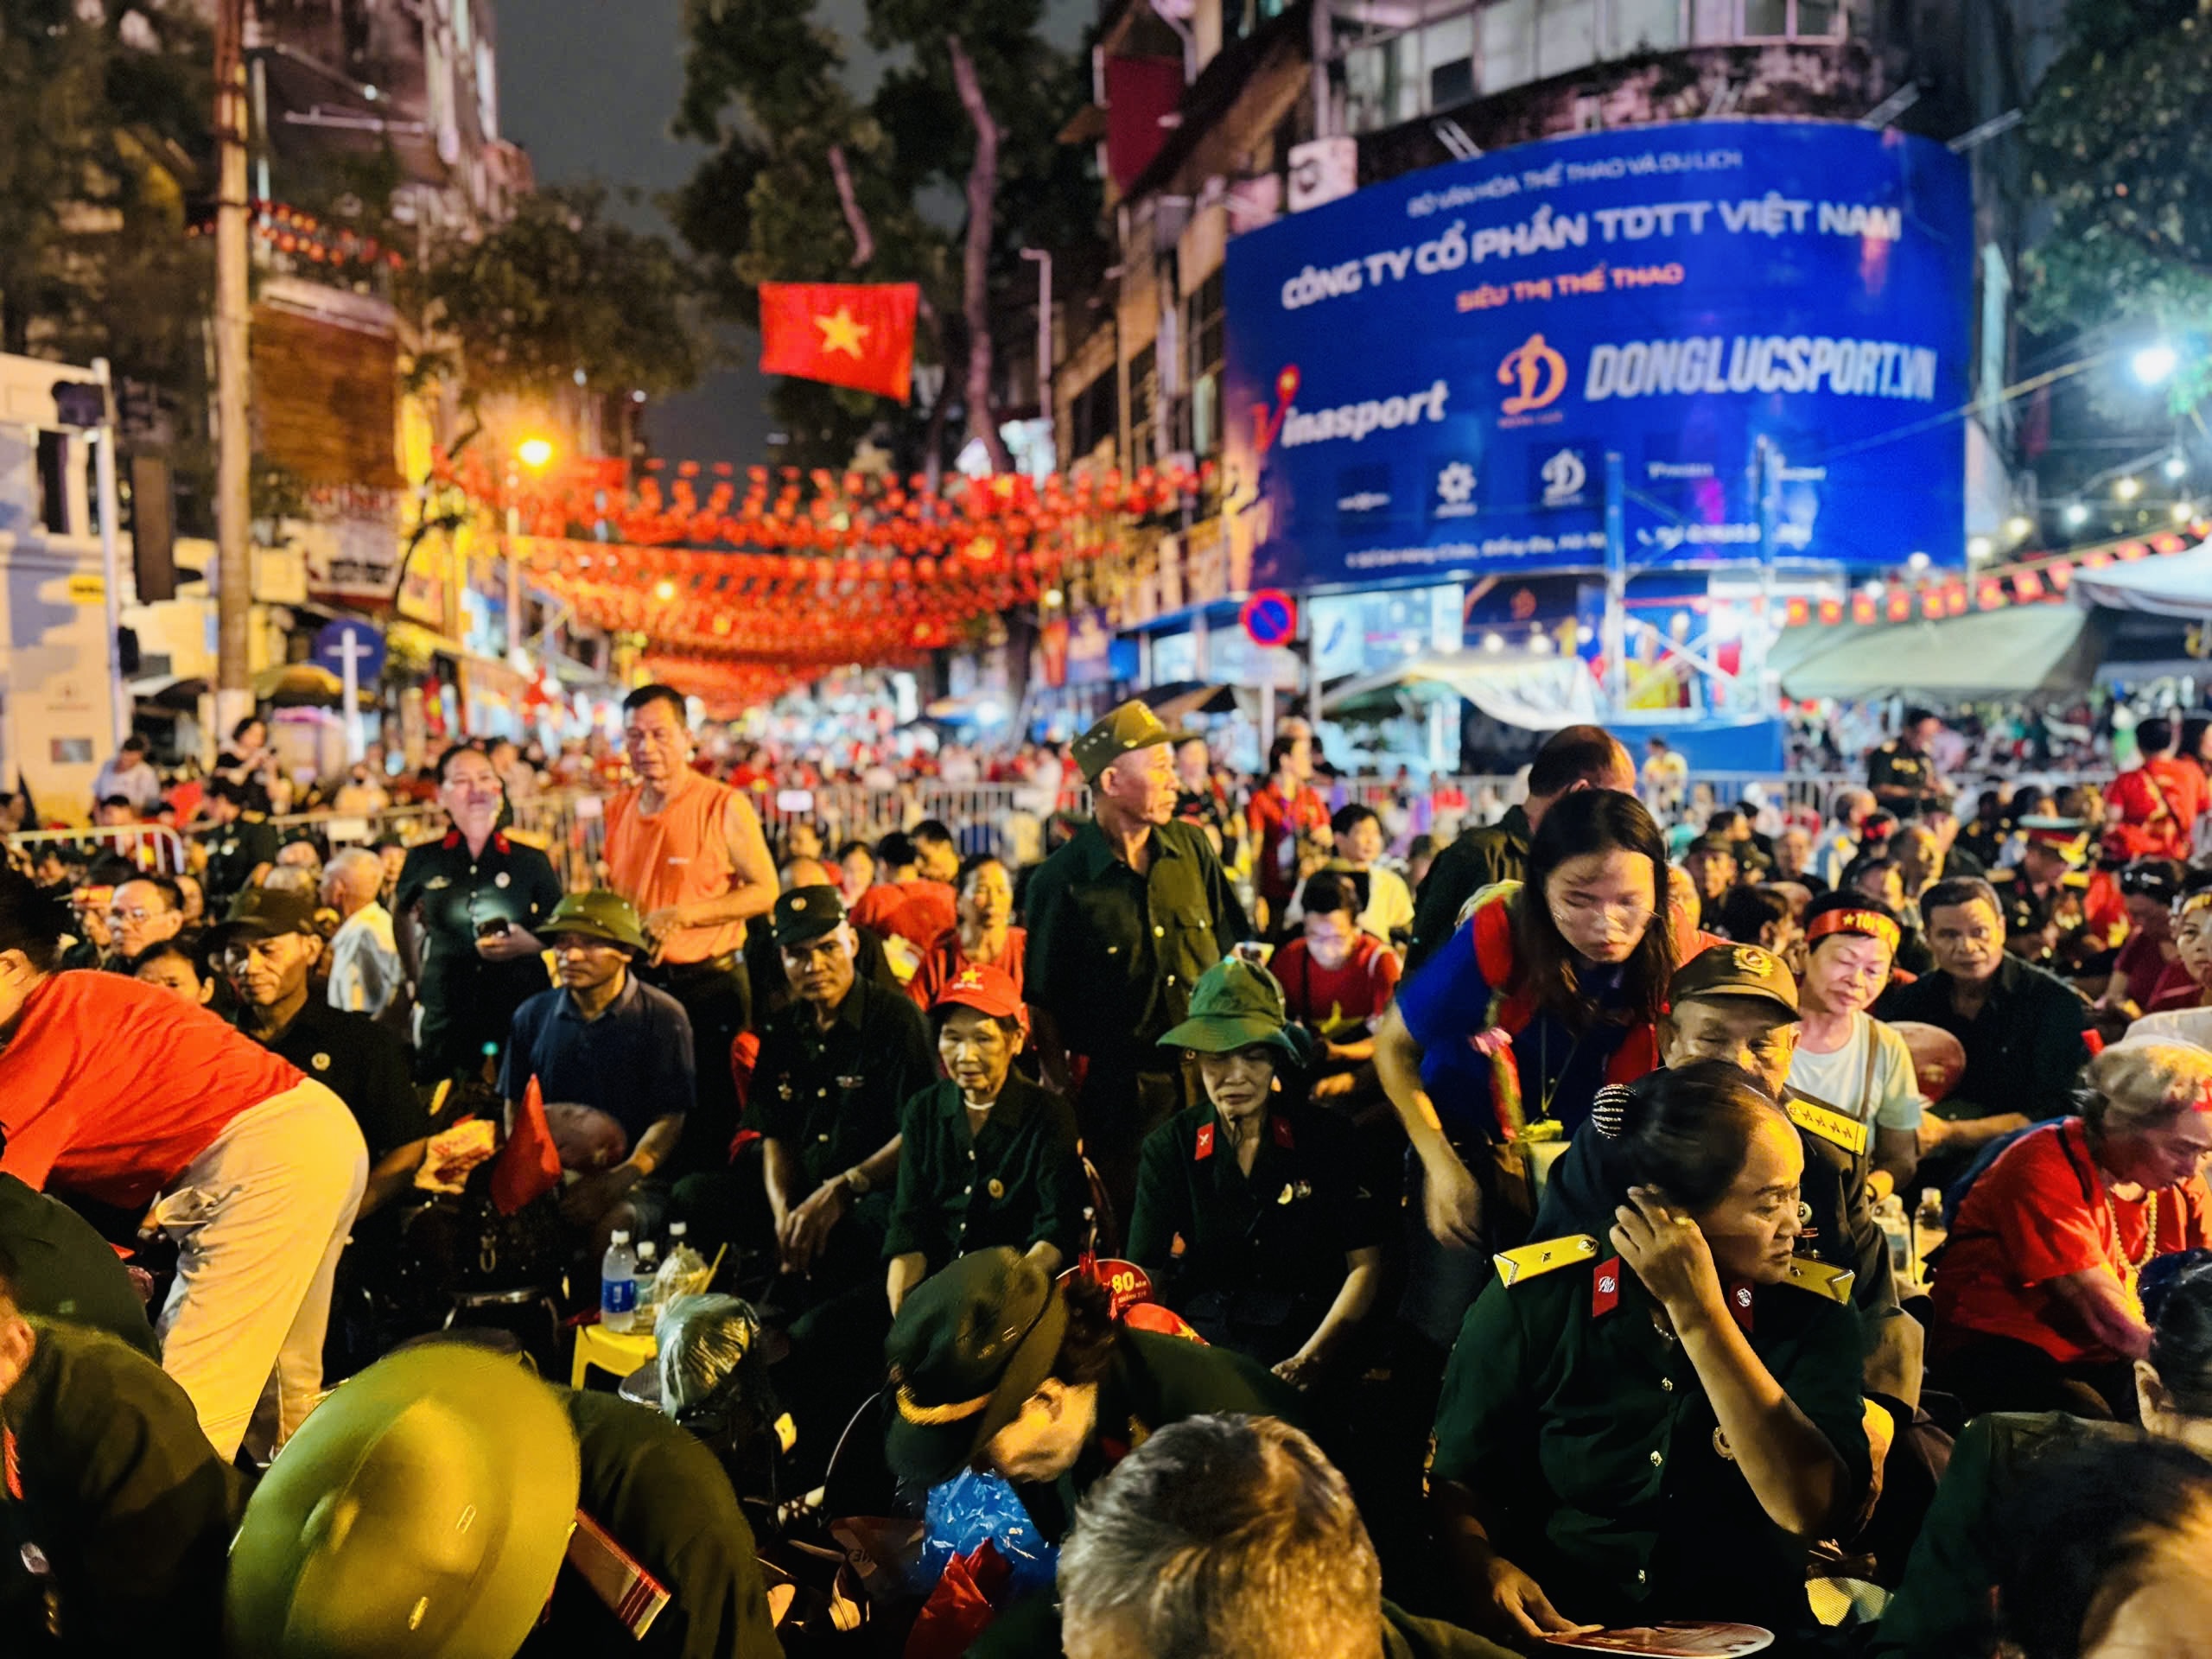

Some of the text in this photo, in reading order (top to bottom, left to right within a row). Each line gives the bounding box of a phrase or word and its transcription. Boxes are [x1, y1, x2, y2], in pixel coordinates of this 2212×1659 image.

[1567, 156, 1625, 182] THAO
[1281, 262, 1363, 309] CÔNG
[1364, 246, 1412, 286] TY
[1593, 200, 1713, 242] TDTT
[1718, 189, 1813, 238] VIỆT
[1817, 200, 1902, 242] NAM
[1611, 262, 1685, 289] THAO
[1583, 334, 1938, 403] DONGLUCSPORT.VN
[1252, 363, 1450, 450] Vinasport
[1111, 1271, 1135, 1294] 80
